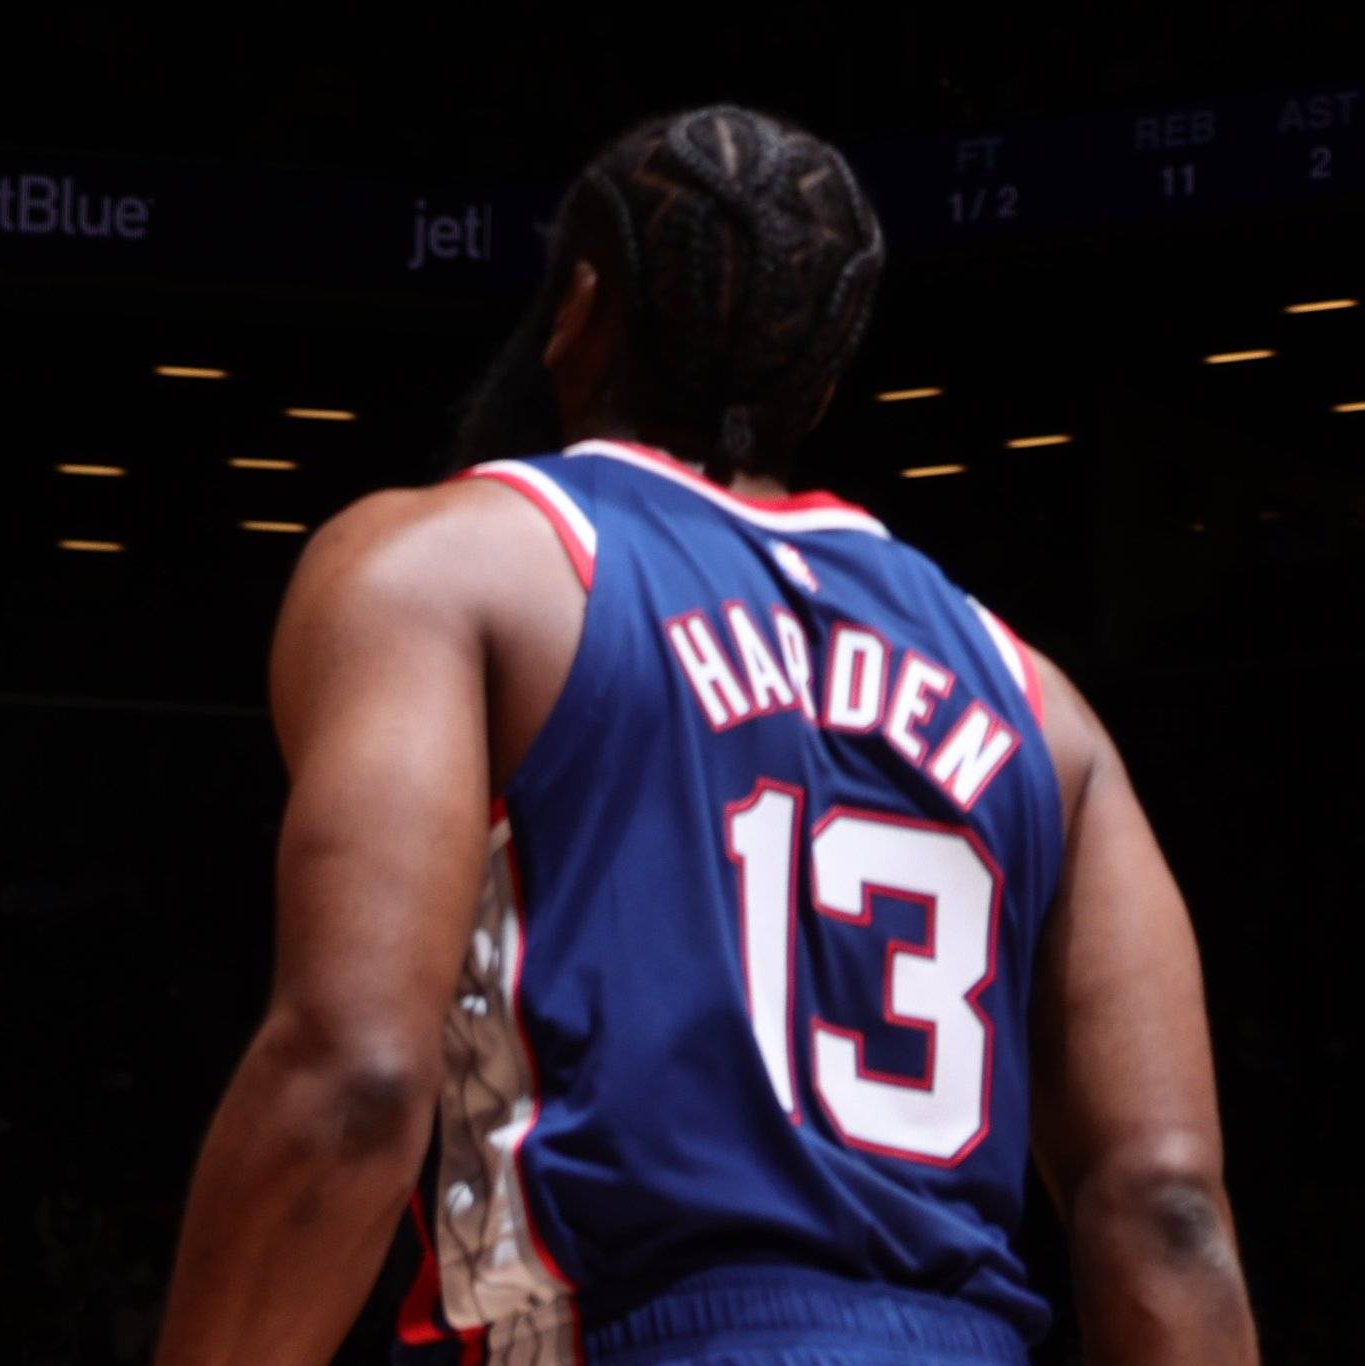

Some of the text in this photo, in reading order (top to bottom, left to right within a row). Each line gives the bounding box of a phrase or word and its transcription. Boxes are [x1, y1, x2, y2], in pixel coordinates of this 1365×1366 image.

[954, 90, 1361, 173] FT REB AST
[1159, 163, 1198, 199] 11
[1309, 146, 1334, 180] 2
[405, 197, 493, 270] jet
[663, 601, 1021, 813] HARDEN
[724, 776, 1004, 1170] 13
